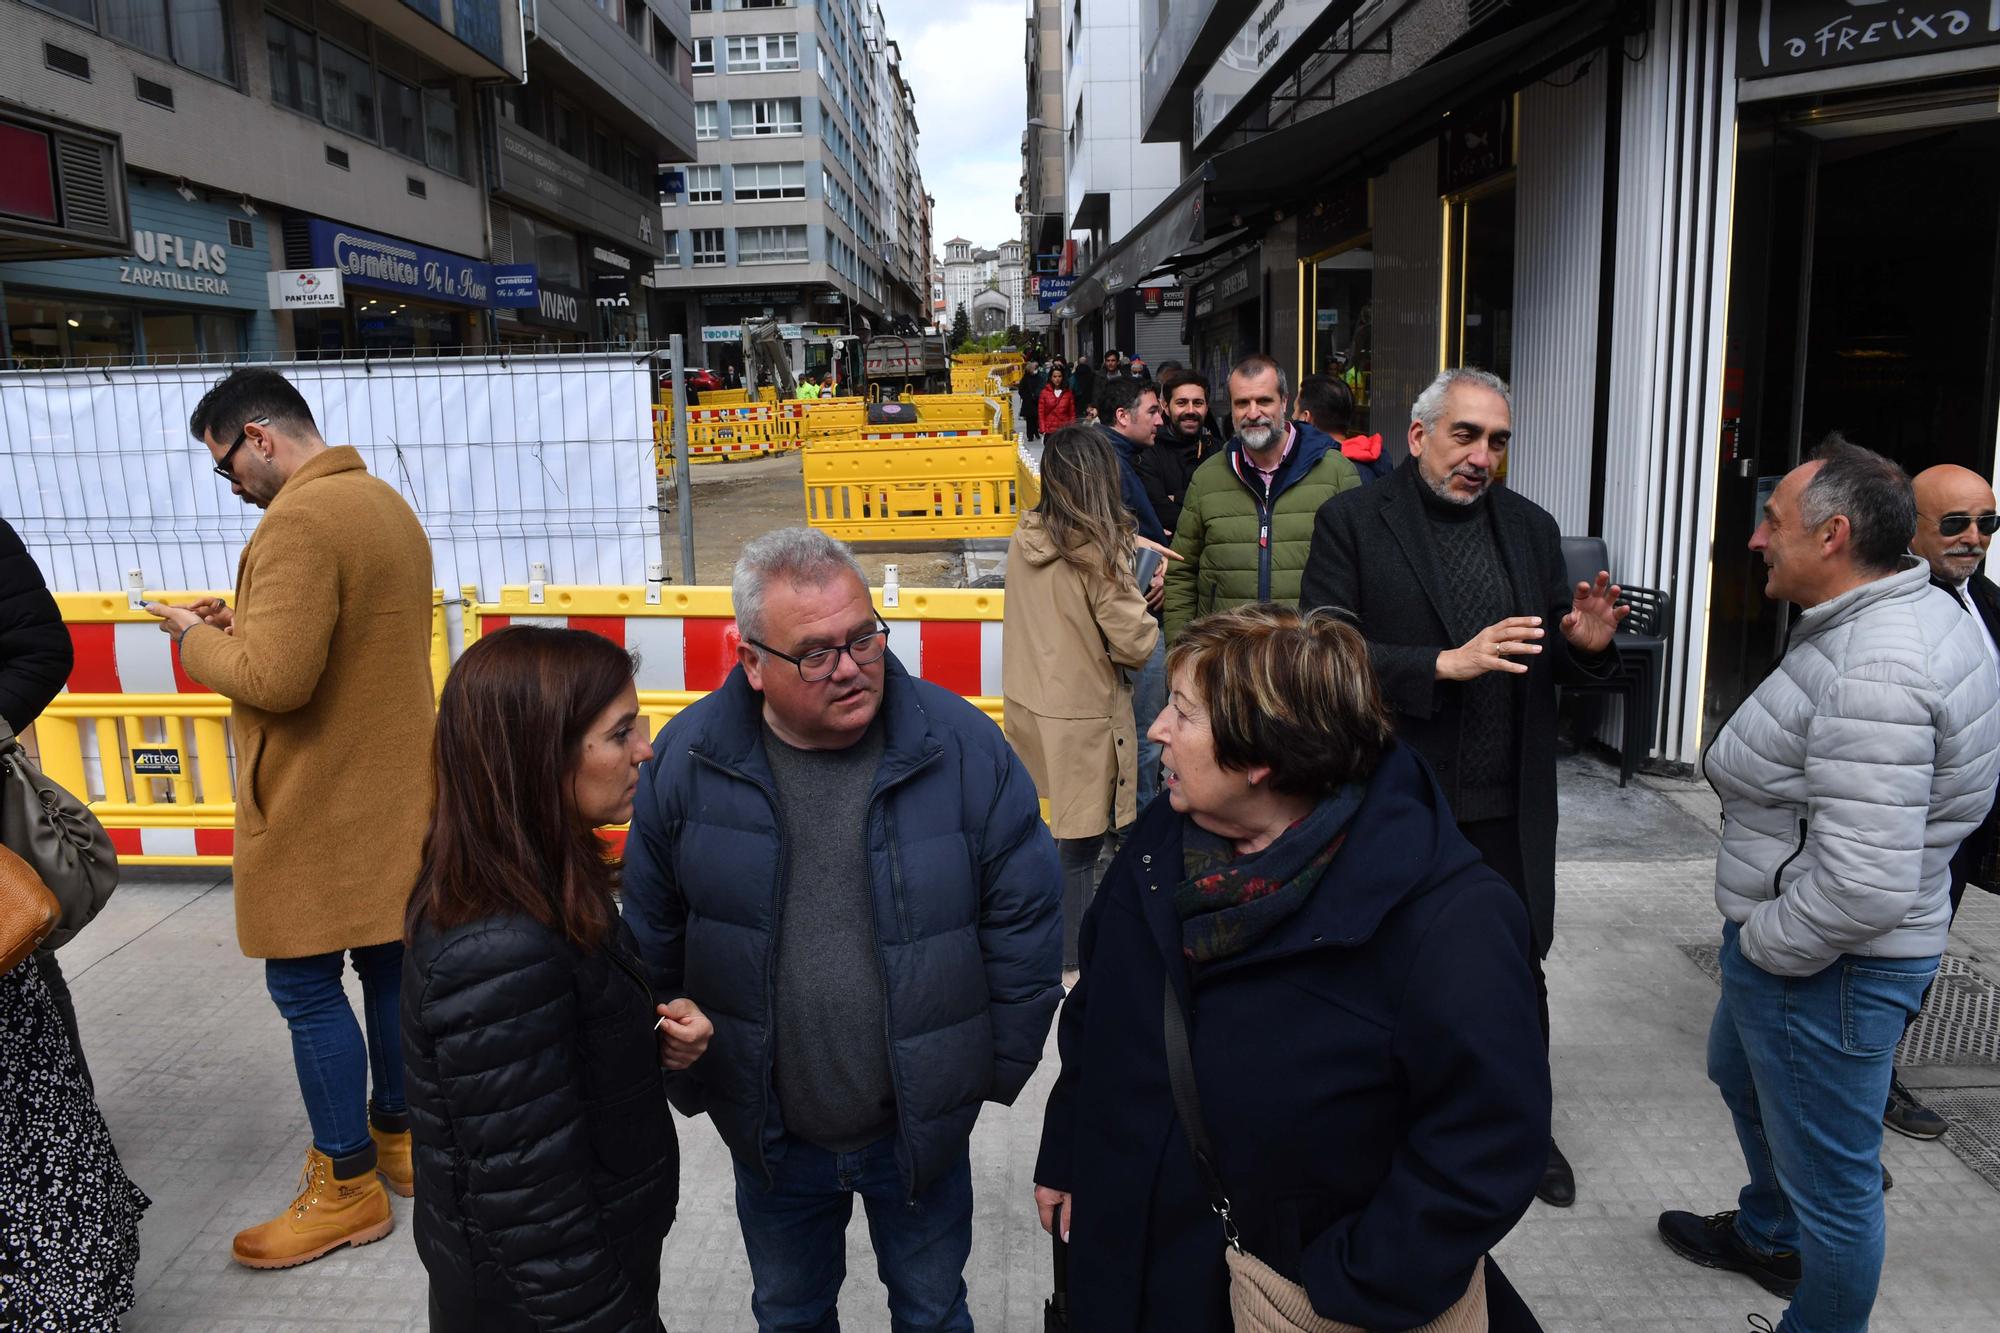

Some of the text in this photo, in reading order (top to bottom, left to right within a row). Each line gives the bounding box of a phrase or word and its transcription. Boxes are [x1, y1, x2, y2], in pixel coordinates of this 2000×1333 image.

[119, 266, 230, 296] ZAPATILLERIA
[423, 262, 443, 292] De
[444, 266, 455, 295] la
[457, 268, 487, 301] Rosa
[495, 275, 533, 285] Cosméticos
[1050, 279, 1074, 288] Taba
[285, 294, 335, 302] PANTUFLAS
[537, 288, 578, 323] VIVAYO
[703, 330, 729, 339] TODO
